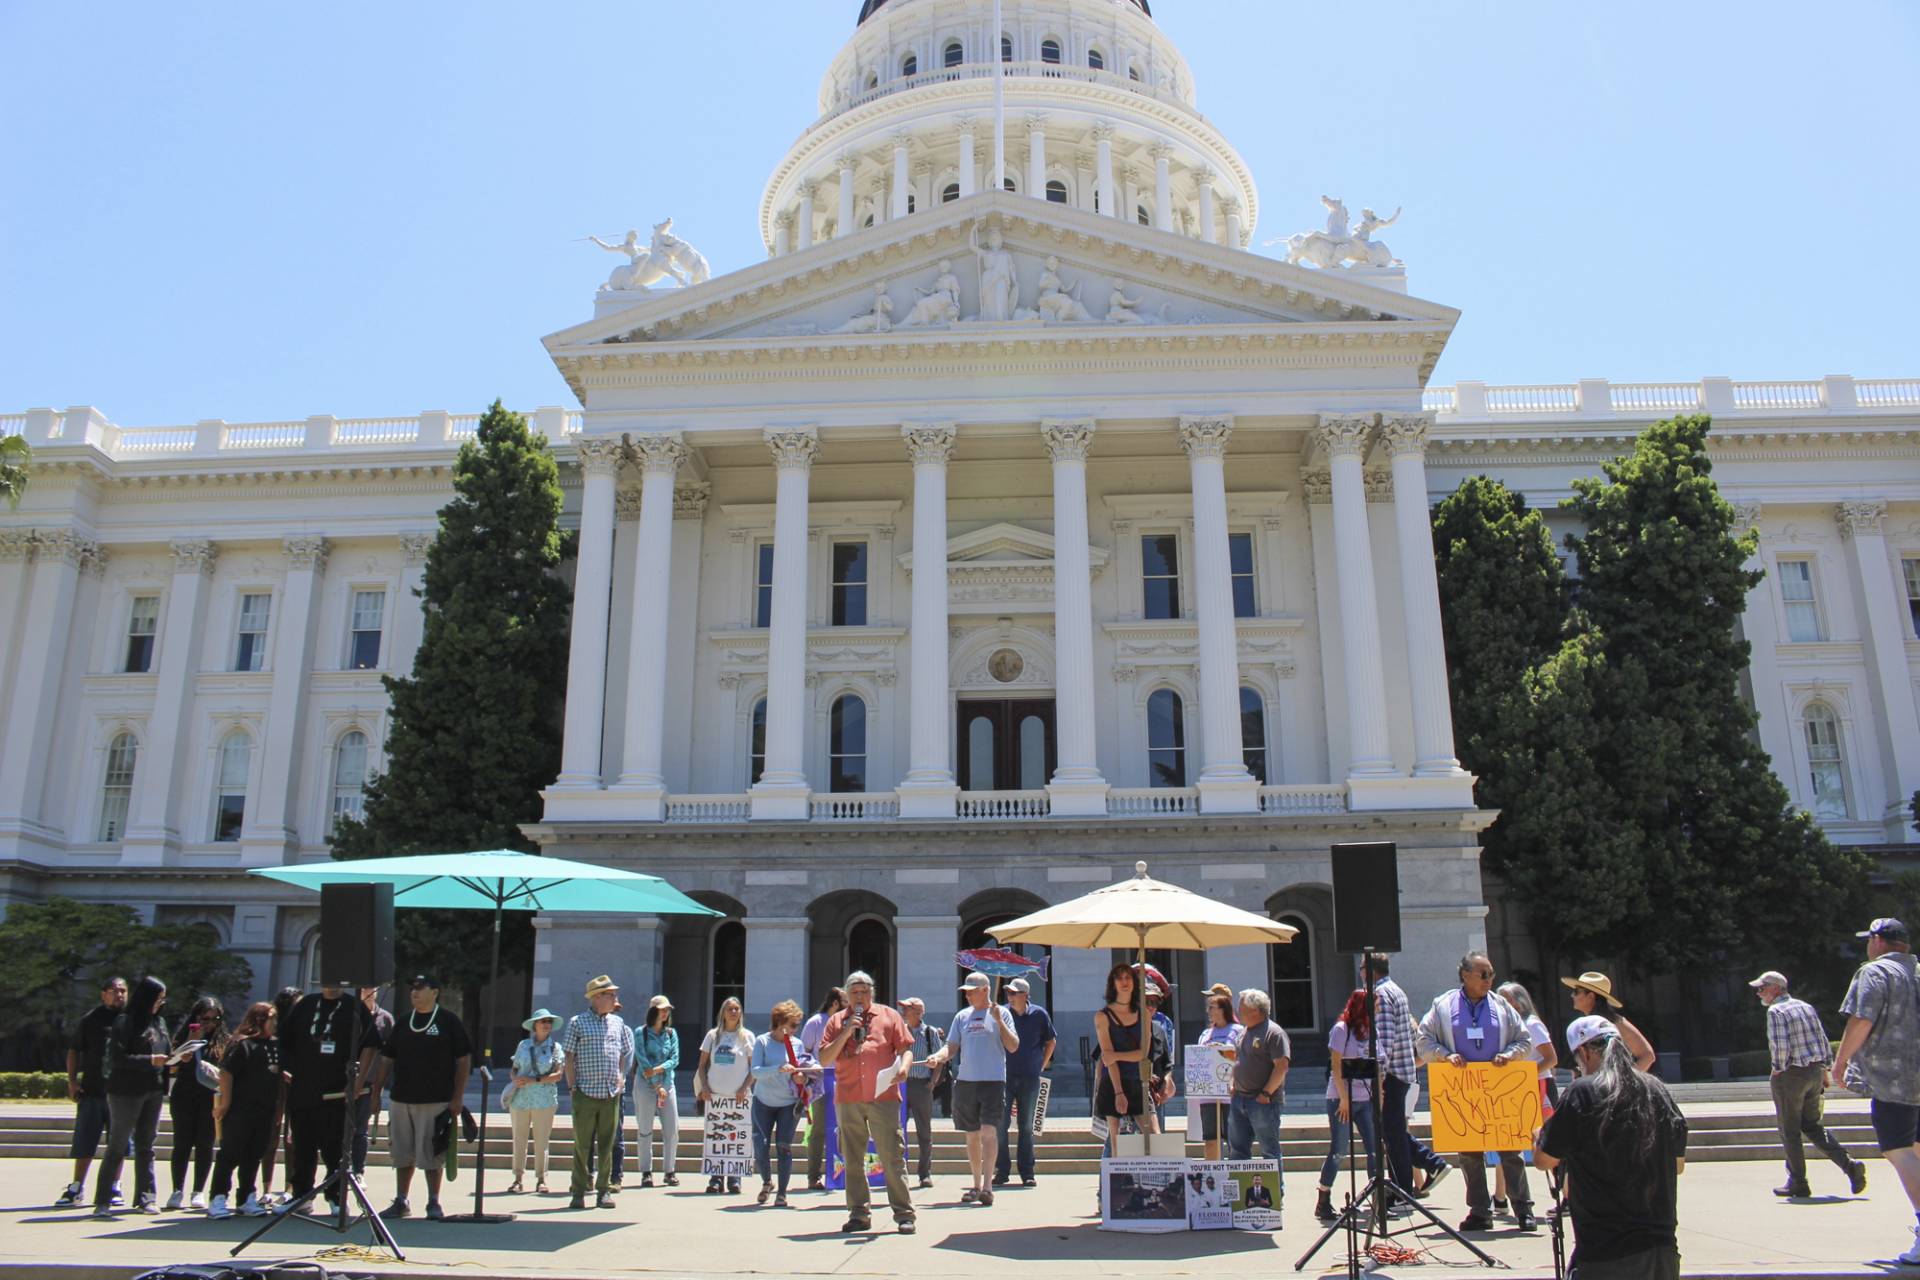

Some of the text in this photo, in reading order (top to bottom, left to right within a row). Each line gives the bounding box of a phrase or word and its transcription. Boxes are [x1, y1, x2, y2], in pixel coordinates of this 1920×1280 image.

[1441, 1069, 1489, 1092] WINE
[710, 1098, 750, 1110] WATER
[1033, 1082, 1048, 1132] GOVERNOR
[1470, 1097, 1521, 1120] KILLS
[737, 1130, 747, 1140] IS
[1481, 1123, 1519, 1147] FISH
[712, 1143, 745, 1155] LIFE
[1226, 1163, 1241, 1171] THAT
